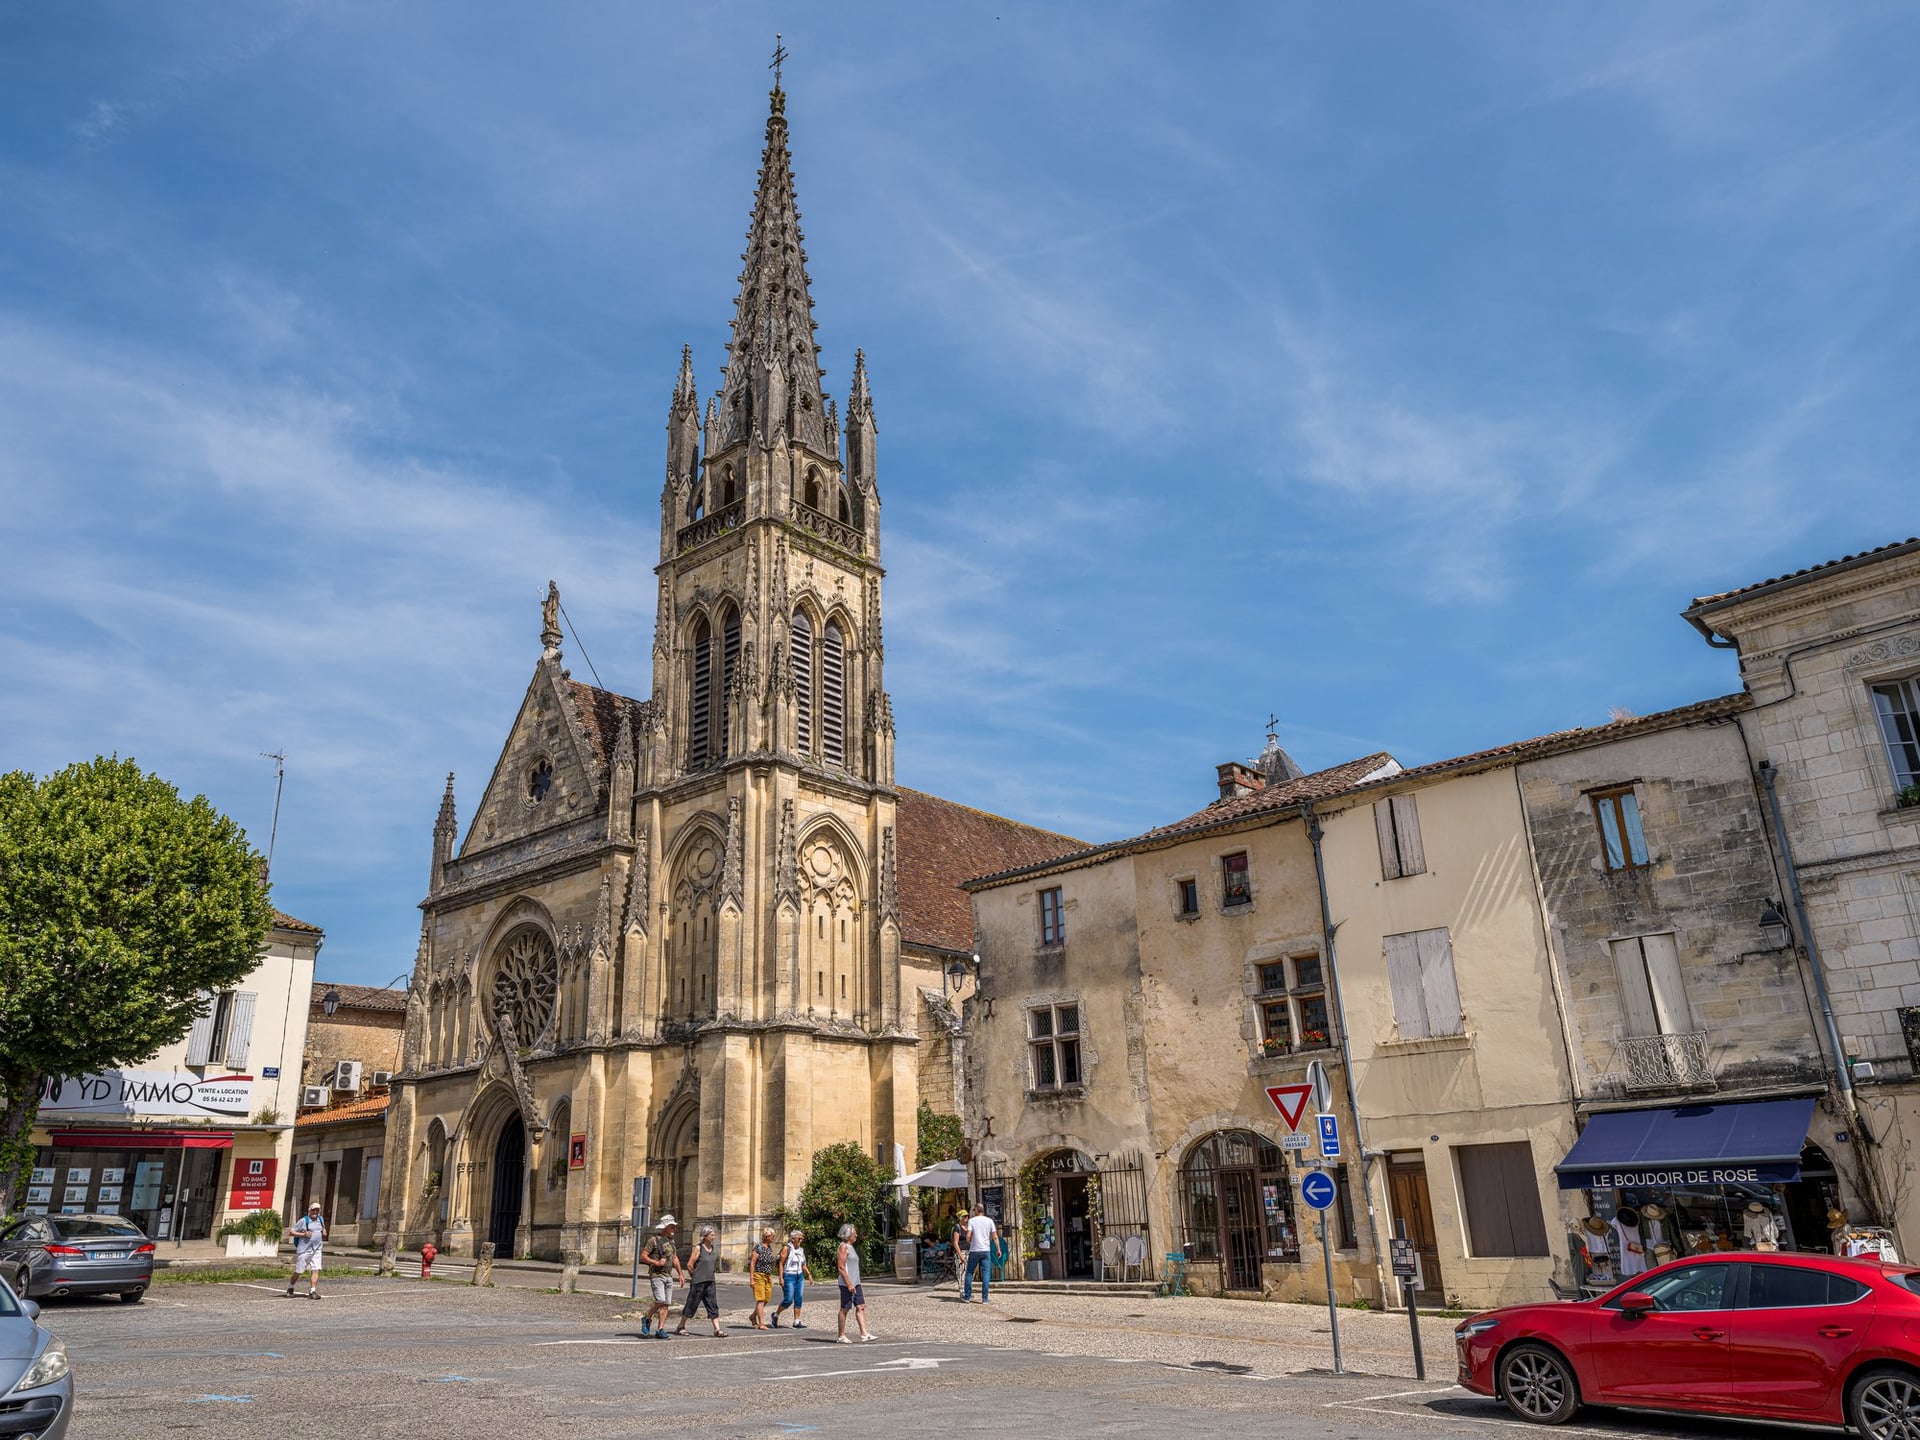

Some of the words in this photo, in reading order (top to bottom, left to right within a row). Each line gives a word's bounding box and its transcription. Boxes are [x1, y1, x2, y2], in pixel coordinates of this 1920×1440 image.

[79, 1079, 111, 1101] YD
[119, 1081, 193, 1104] IMMO
[1593, 1174, 1611, 1187] LE
[1614, 1172, 1684, 1186] BOUDOIR
[1687, 1171, 1709, 1183] DE
[1713, 1169, 1759, 1182] ROSE
